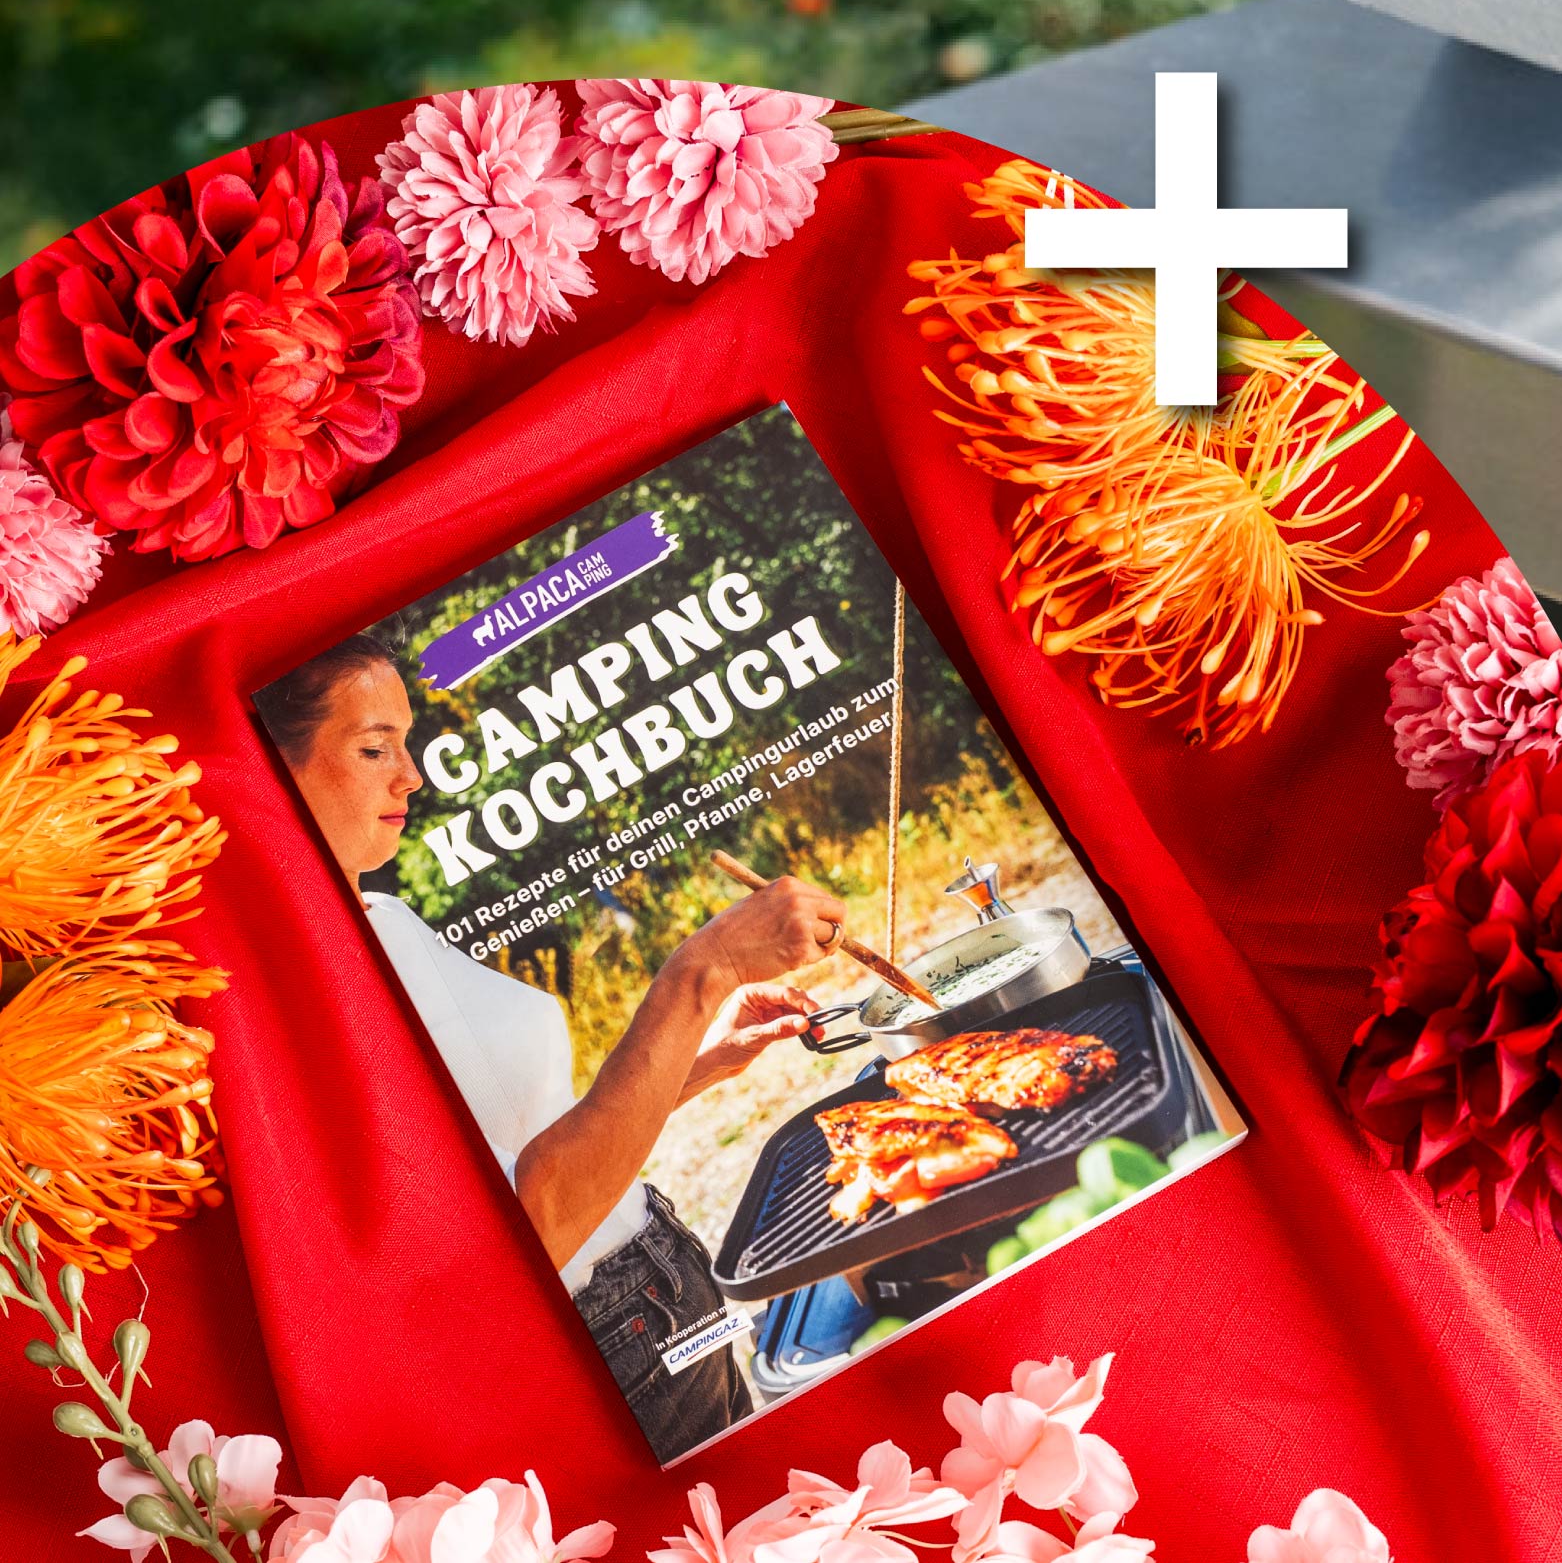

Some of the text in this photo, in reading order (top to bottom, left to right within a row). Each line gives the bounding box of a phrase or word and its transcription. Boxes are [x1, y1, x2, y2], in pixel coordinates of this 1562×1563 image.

[577, 551, 605, 575] CAM
[583, 563, 613, 587] PING
[494, 568, 587, 636] ALPACA
[422, 572, 764, 794] CAMPING
[422, 615, 842, 887] KOCHBUCH
[435, 677, 901, 949] 101 Rezepte für deinen Campingurlaub zum
[470, 895, 576, 961] Genießen
[592, 865, 625, 892] für
[630, 833, 685, 870] Grill,
[683, 788, 772, 839] Pfanne,
[770, 711, 893, 789] Lagerfeuer
[655, 1341, 666, 1351] In
[665, 1310, 719, 1345] Kooperation
[669, 1317, 740, 1364] CAMPINGAZ
